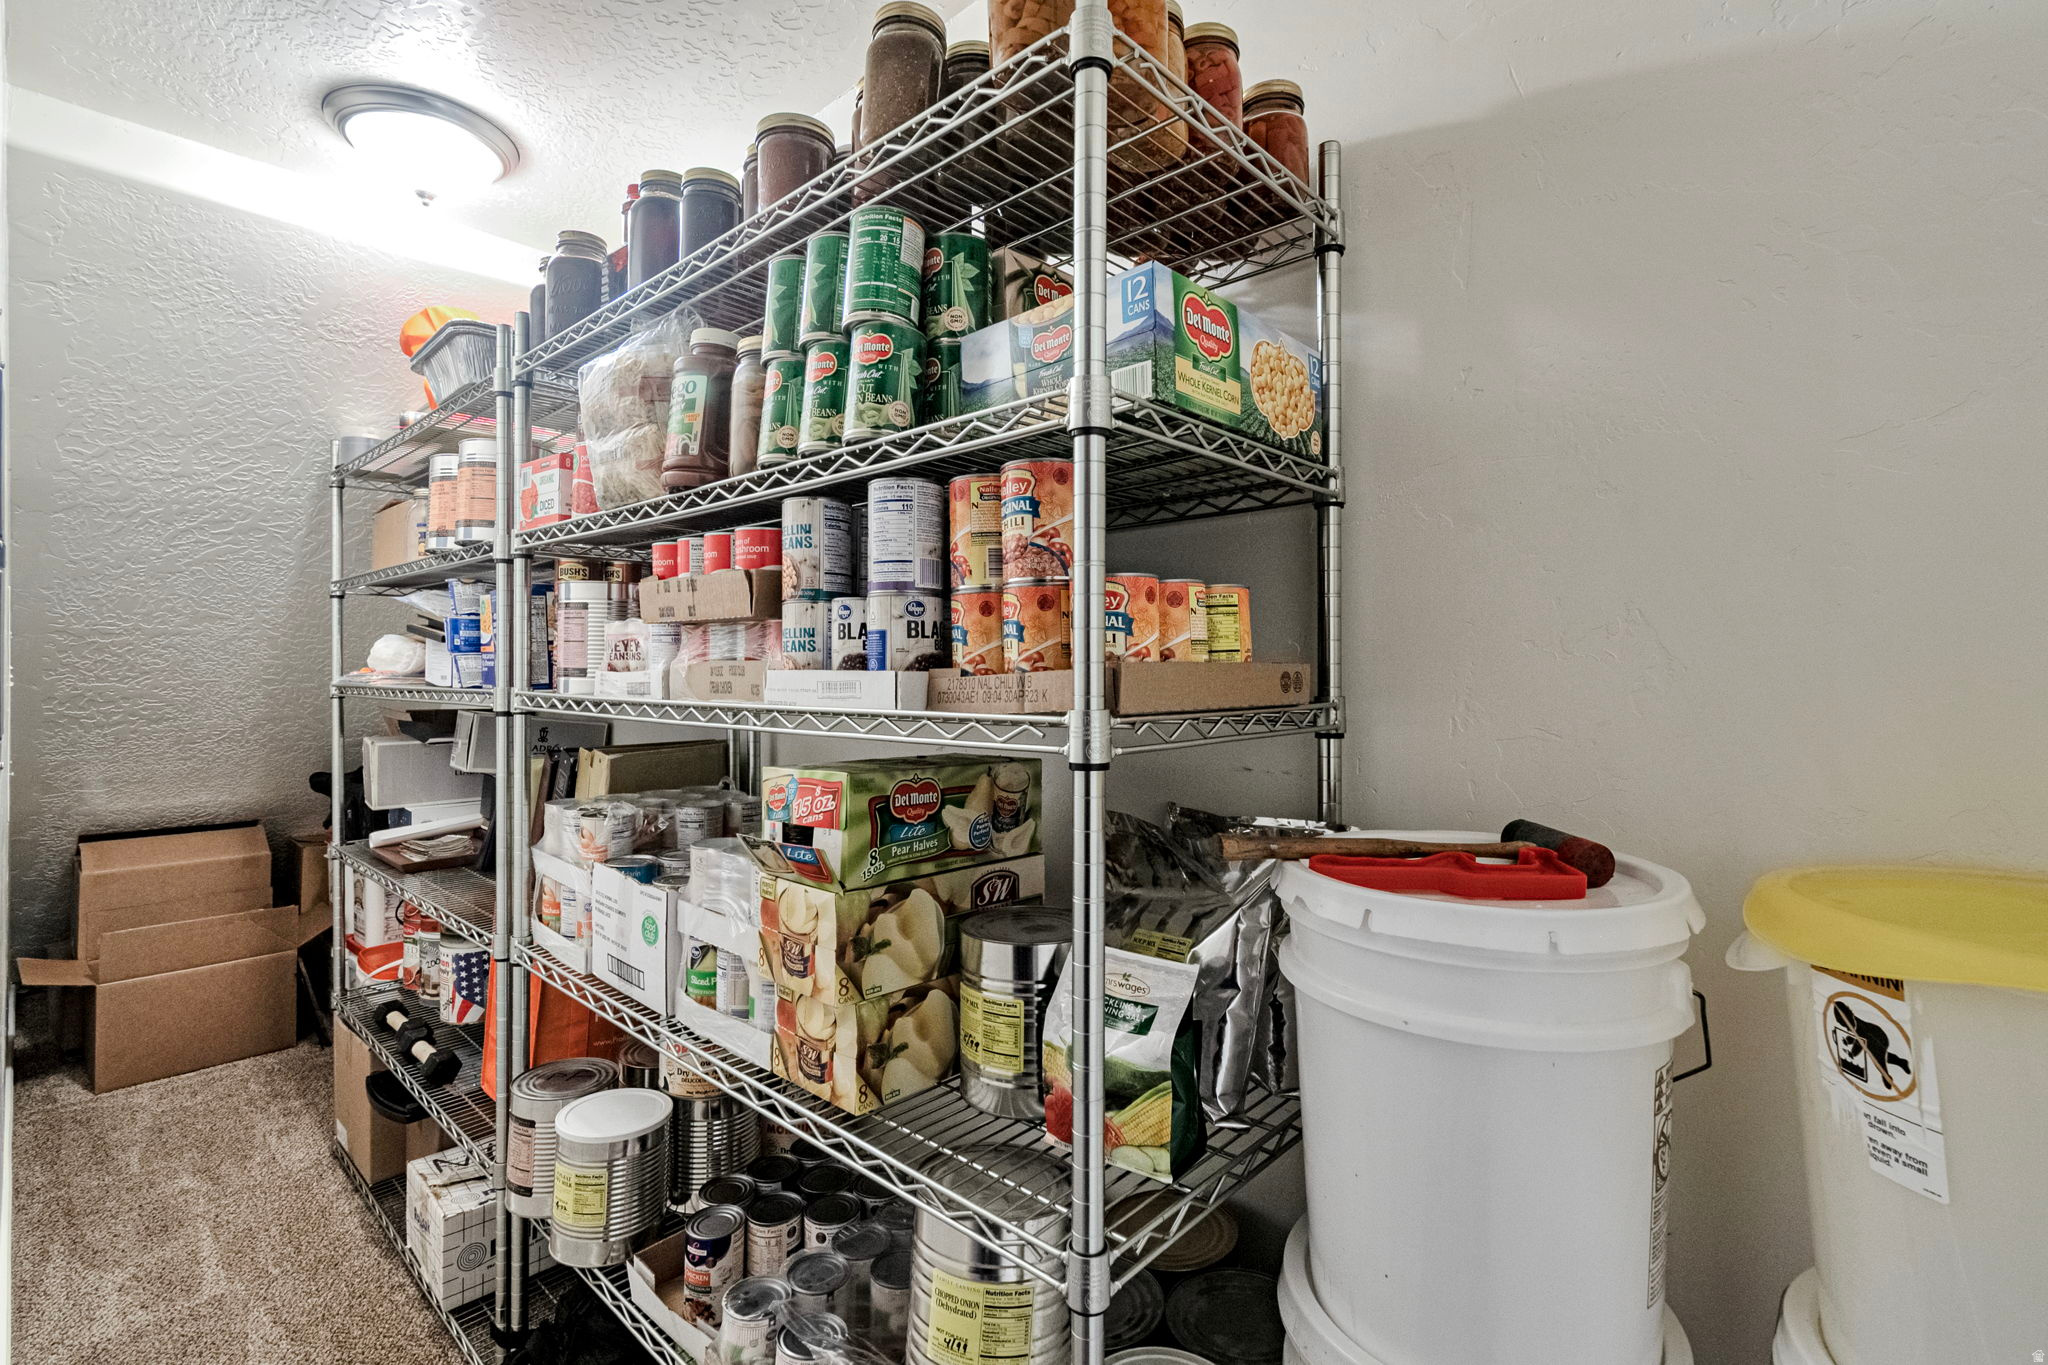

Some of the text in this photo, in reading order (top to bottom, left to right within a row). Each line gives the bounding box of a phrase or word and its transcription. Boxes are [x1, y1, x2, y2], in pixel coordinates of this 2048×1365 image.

[884, 213, 902, 222] Facts
[879, 234, 888, 242] 20
[1126, 276, 1149, 303] 12
[1127, 299, 1150, 316] CANS
[1186, 306, 1230, 344] Del Monte
[863, 342, 890, 352] Monte
[1046, 332, 1070, 350] Monte
[878, 364, 899, 372] WITH
[1178, 370, 1200, 390] WHOLE
[1202, 382, 1222, 399] KERNEL
[1223, 390, 1240, 405] CORN
[865, 393, 893, 403] BEANS
[539, 498, 555, 512] DICED
[560, 567, 588, 577] BUSH'S
[1042, 689, 1048, 703] K
[793, 796, 812, 818] 15
[894, 792, 938, 807] Del Monte
[802, 813, 824, 824] cans
[900, 825, 926, 838] Lite
[786, 848, 814, 861] Lite
[892, 844, 910, 857] Pear
[913, 840, 938, 852] Halves
[868, 848, 879, 867] 8
[861, 867, 872, 881] 15
[838, 976, 850, 997] 8
[676, 1068, 690, 1077] Dry
[858, 1084, 868, 1104] 8
[1874, 1116, 1906, 1136] fall into
[1880, 1142, 1902, 1158] away
[1904, 1152, 1928, 1169] from
[1902, 1160, 1928, 1177] small
[934, 1288, 959, 1305] CHOPPED
[960, 1298, 980, 1310] ONION
[936, 1298, 978, 1320] (Dehydrated)
